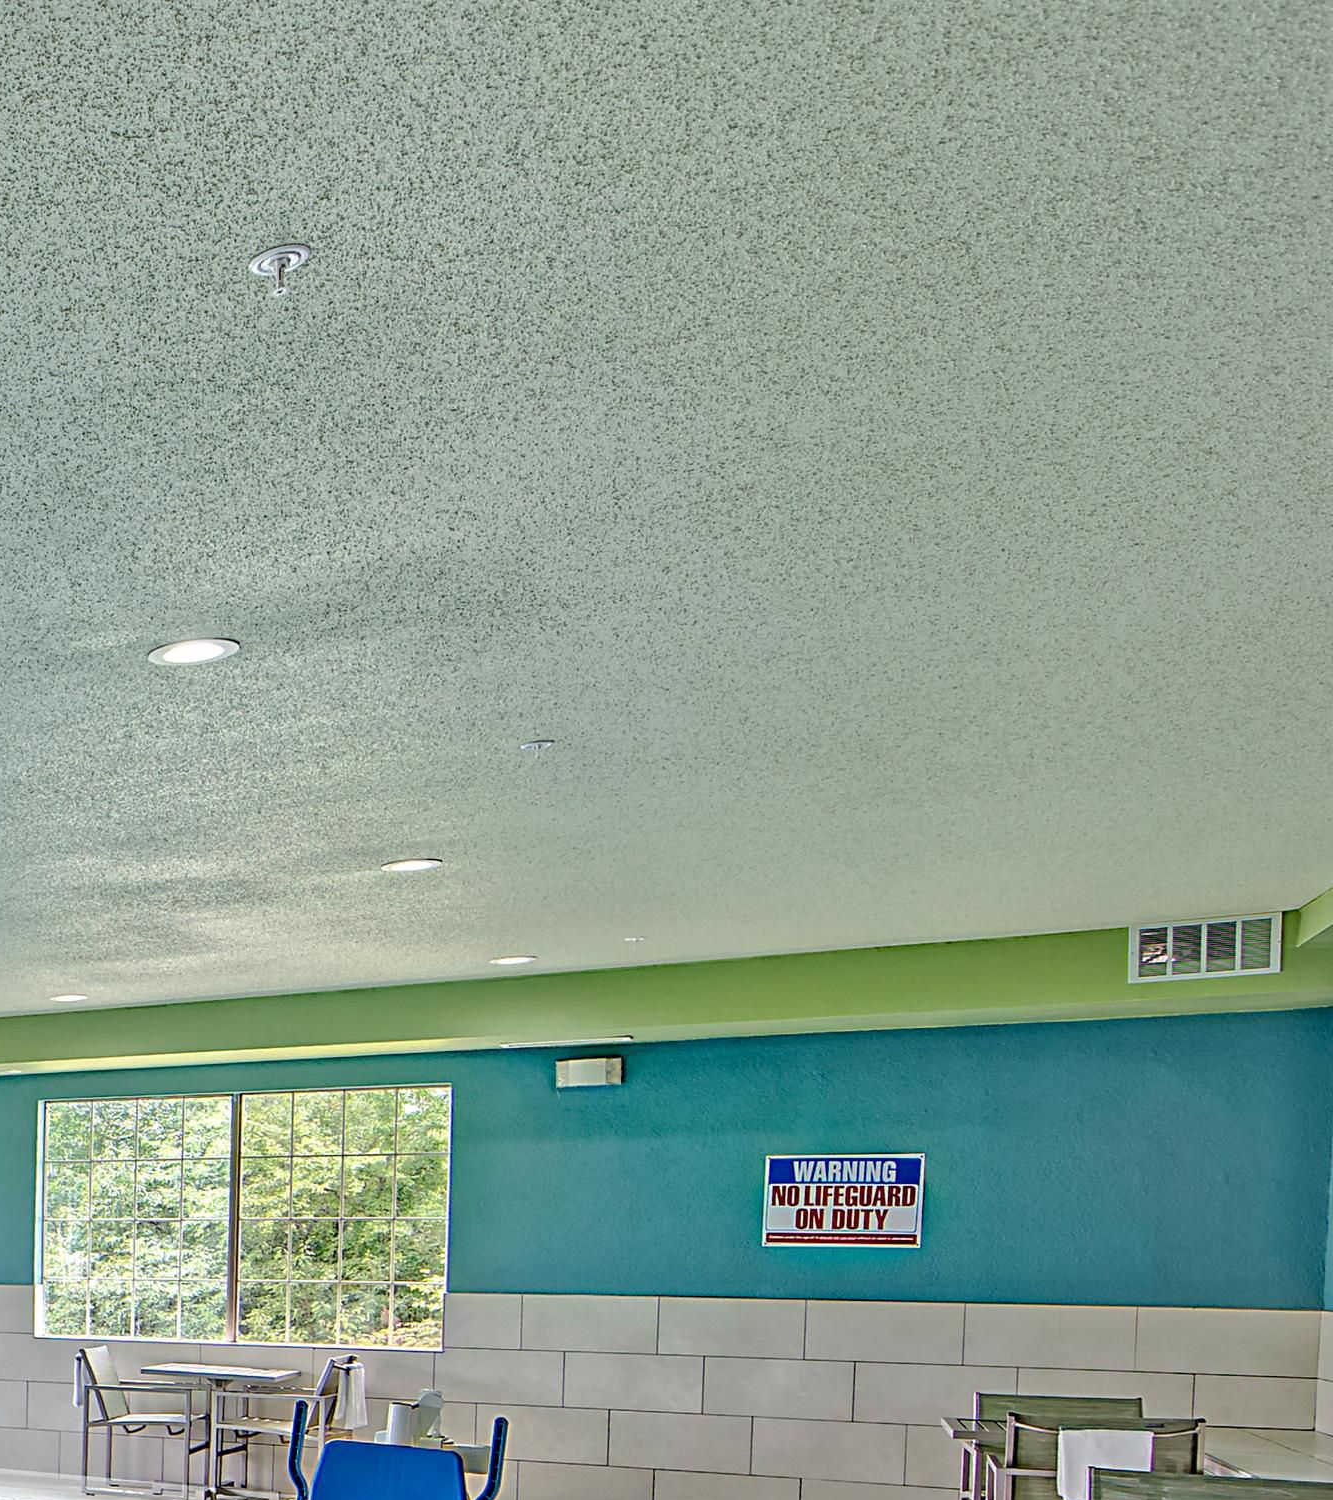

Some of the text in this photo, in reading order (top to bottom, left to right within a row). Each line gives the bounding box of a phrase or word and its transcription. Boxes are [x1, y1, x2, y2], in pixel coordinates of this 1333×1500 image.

[793, 1160, 897, 1183] WARNING
[771, 1185, 917, 1207] NO LIFEGUARD
[795, 1208, 889, 1230] ON DUTY
